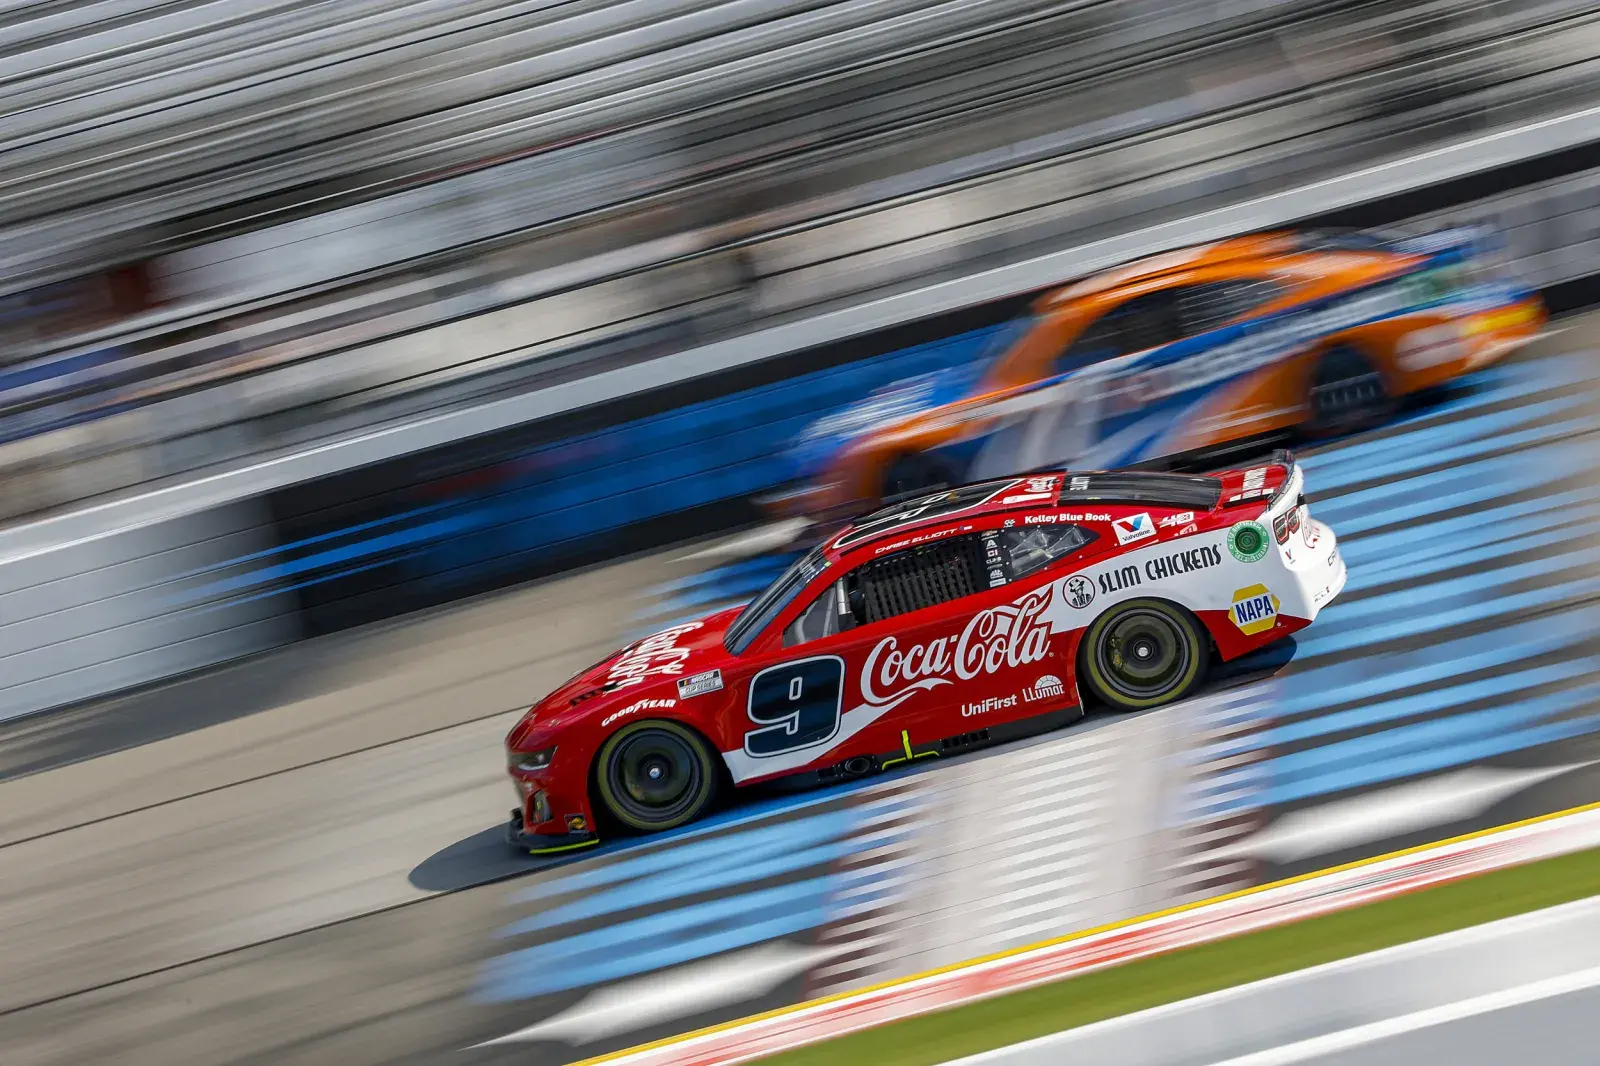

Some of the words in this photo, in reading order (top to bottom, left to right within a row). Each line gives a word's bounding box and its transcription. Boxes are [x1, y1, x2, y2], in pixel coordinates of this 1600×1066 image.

[1024, 514, 1058, 524] Kelley
[1059, 513, 1083, 522] Blue
[1085, 512, 1111, 522] Book
[874, 539, 911, 554] CHASE
[911, 528, 958, 544] ELLIOTT
[1121, 529, 1151, 542] Valvoline
[1098, 565, 1142, 595] SLIM
[1144, 543, 1222, 581] CHICKENS
[1235, 595, 1275, 624] NAPA
[860, 594, 1052, 705] Coca-Cola
[601, 698, 677, 727] GOODYEAR
[744, 654, 846, 758] 9
[961, 693, 1018, 717] UniFirst
